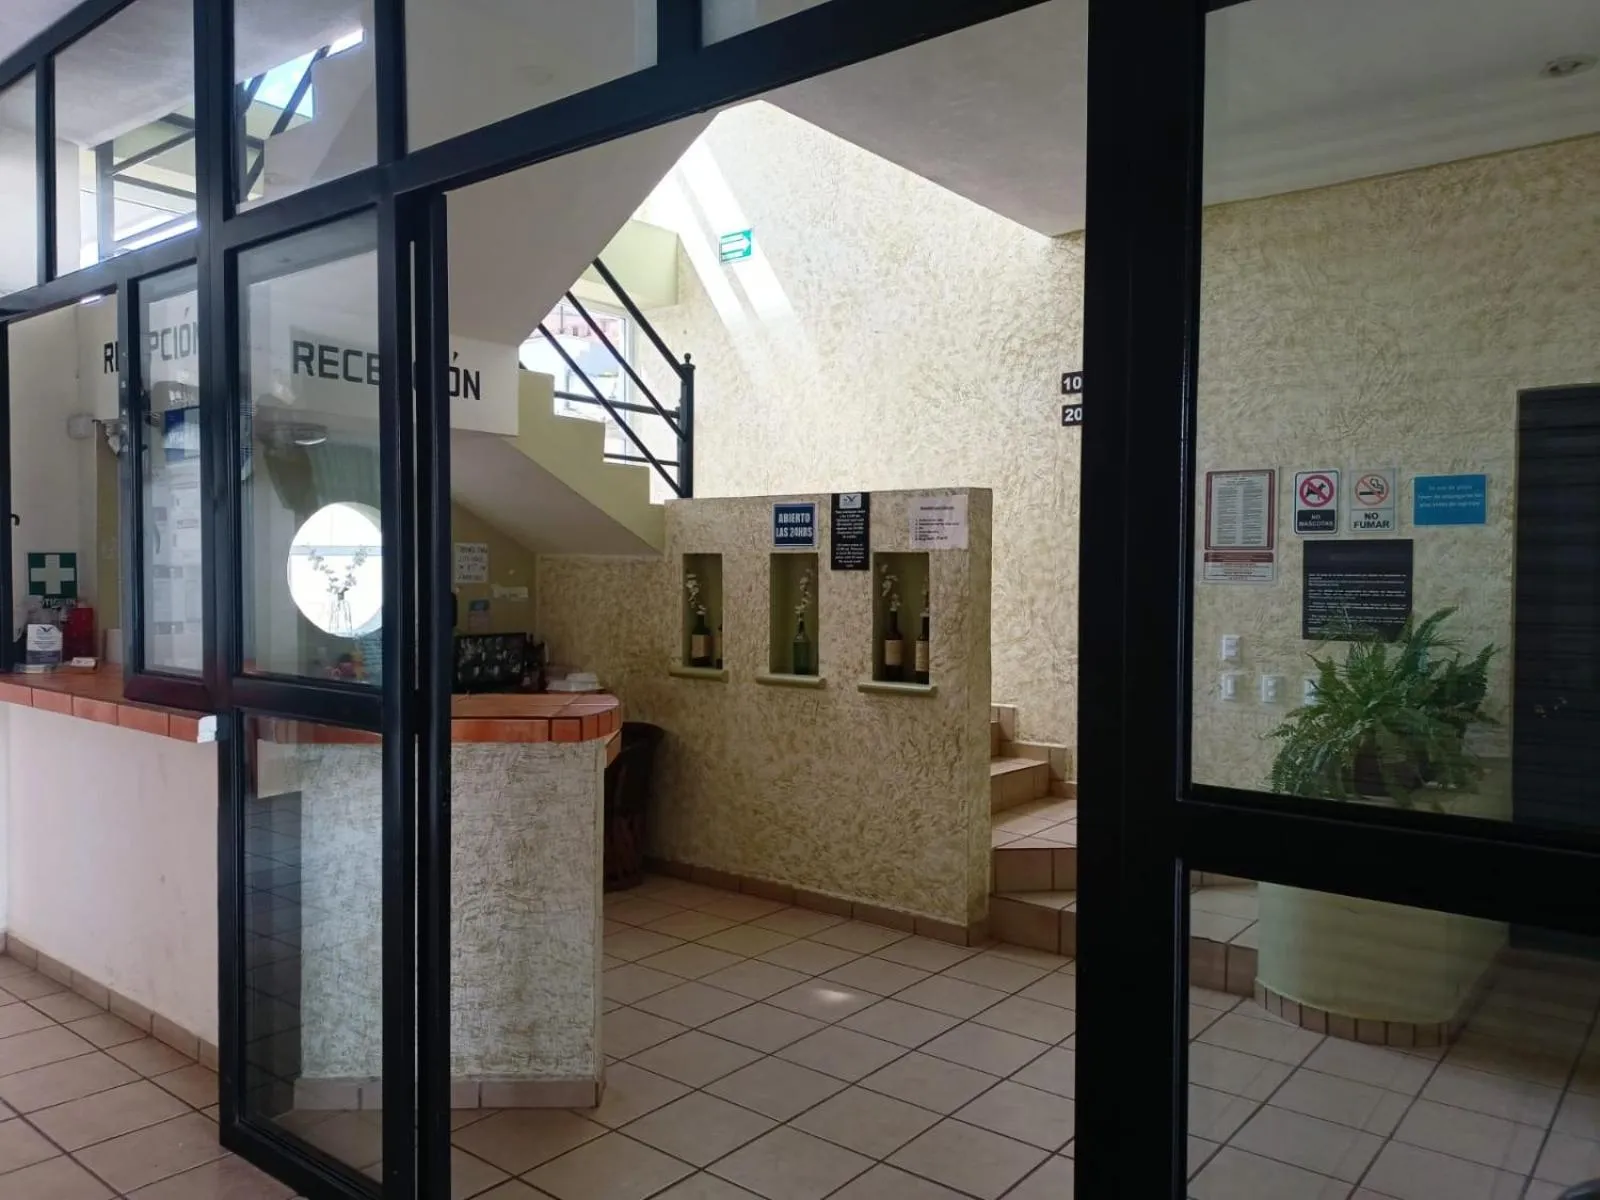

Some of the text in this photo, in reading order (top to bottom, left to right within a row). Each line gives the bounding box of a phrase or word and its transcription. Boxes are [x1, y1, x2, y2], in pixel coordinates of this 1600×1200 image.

[293, 340, 481, 401] RECEÓN
[778, 512, 811, 524] ABIERTO
[1311, 513, 1321, 521] NO
[1364, 512, 1379, 520] NO
[1353, 521, 1390, 529] FUMAR
[775, 527, 789, 538] LAS
